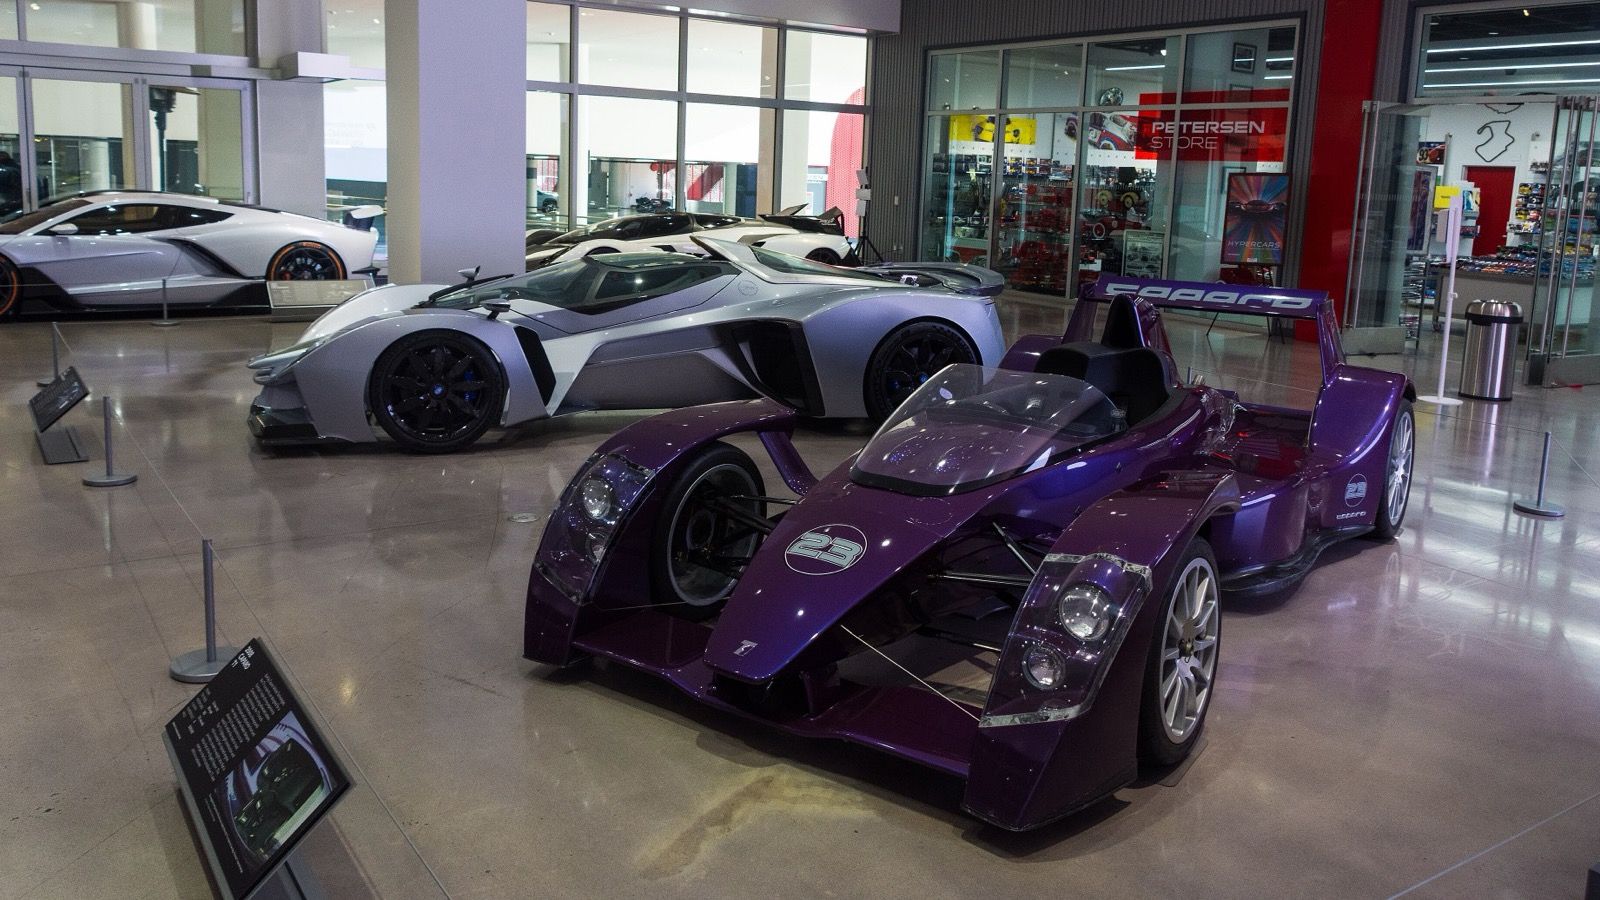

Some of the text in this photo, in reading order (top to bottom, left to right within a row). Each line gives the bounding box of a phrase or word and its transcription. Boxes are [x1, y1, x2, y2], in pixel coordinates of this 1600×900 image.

[1151, 120, 1266, 134] PETERSEN
[1151, 136, 1219, 150] STORE
[1227, 240, 1281, 249] HYPERCARS
[1345, 482, 1366, 499] 23
[786, 531, 864, 568] 23
